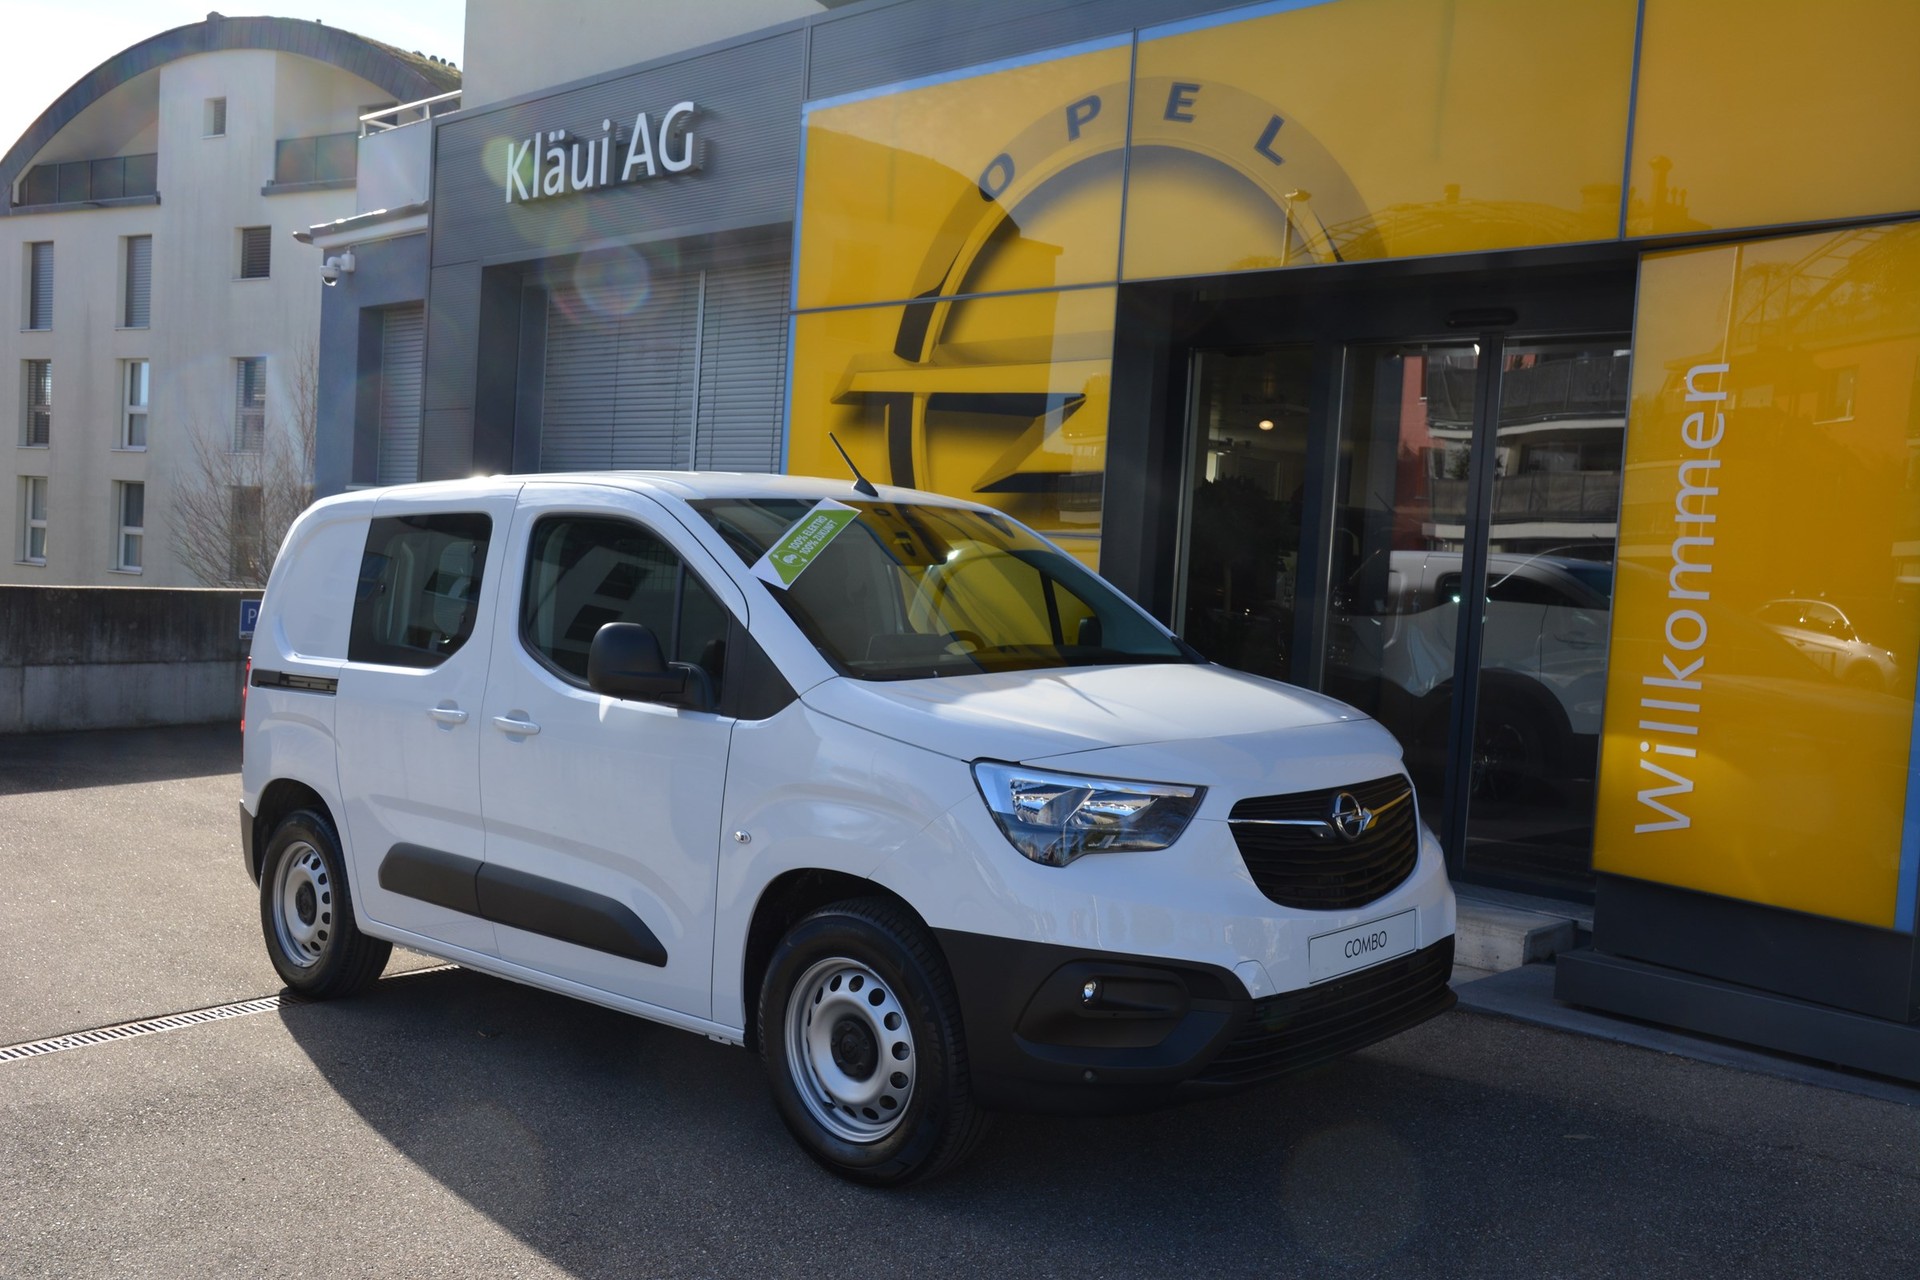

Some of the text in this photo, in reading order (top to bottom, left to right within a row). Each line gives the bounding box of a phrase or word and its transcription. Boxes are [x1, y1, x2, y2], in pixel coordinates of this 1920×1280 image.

[506, 101, 697, 203] Kläui AG
[978, 81, 1286, 202] OPEL
[788, 515, 828, 550] 100% ELEKTRO
[800, 519, 838, 555] 100% ZUKUNFT
[248, 608, 257, 624] P
[1634, 362, 1730, 834] Willkommen
[1344, 930, 1387, 958] COMBO
